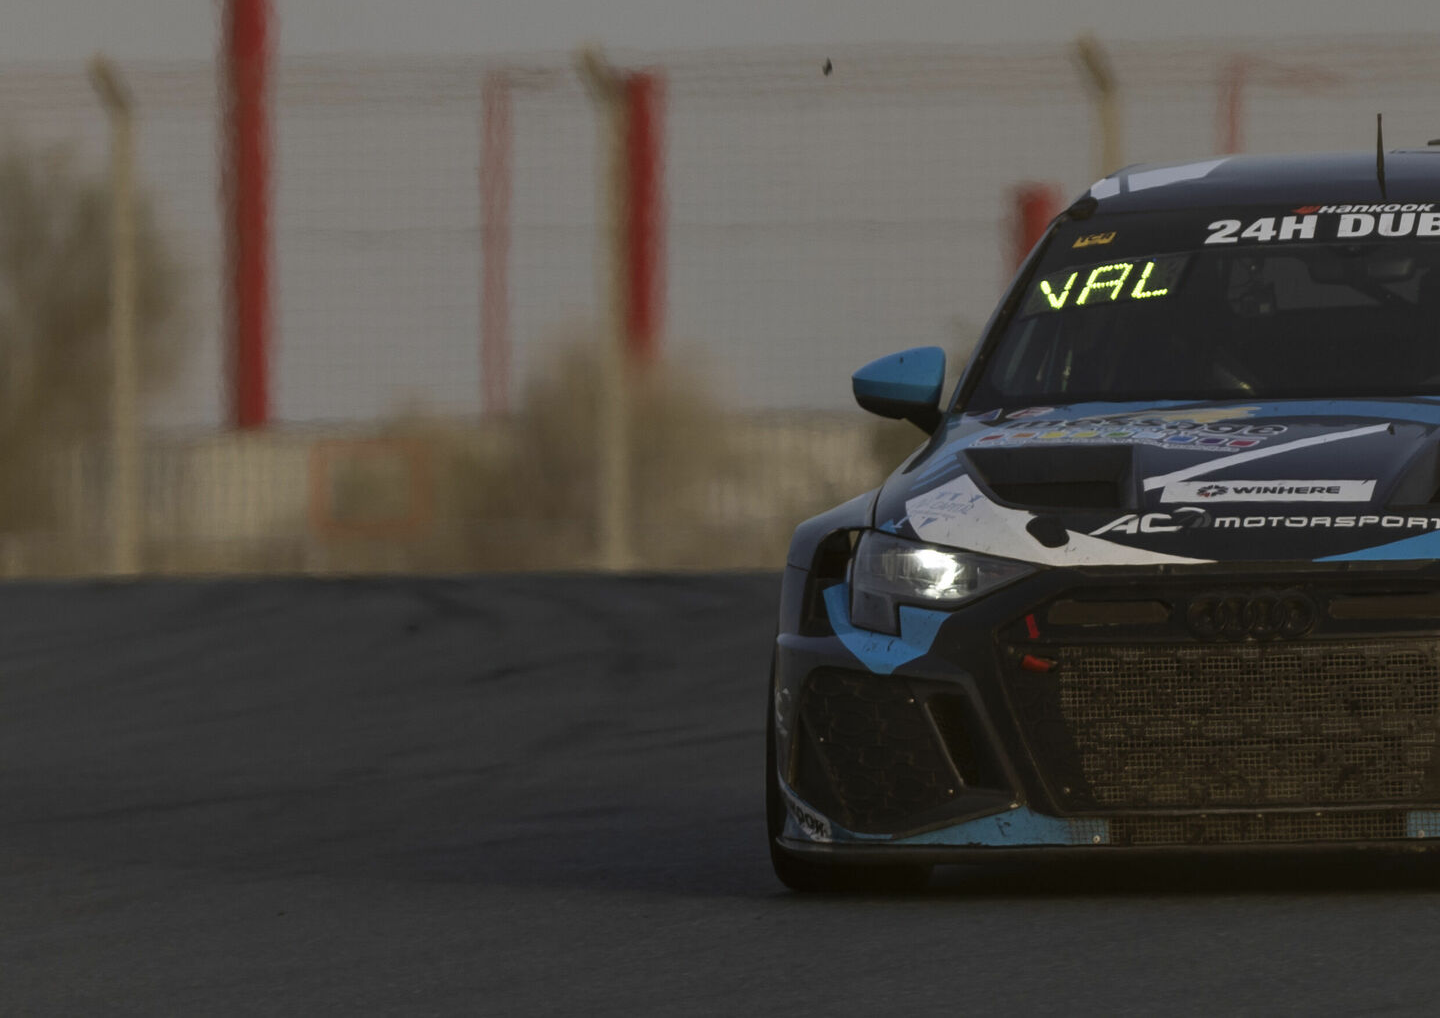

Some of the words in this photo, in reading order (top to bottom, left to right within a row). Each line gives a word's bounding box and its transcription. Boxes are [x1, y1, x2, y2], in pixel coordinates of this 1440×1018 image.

[1203, 213, 1319, 245] 24H
[1039, 261, 1169, 310] VAL
[1232, 485, 1341, 495] WINHERE
